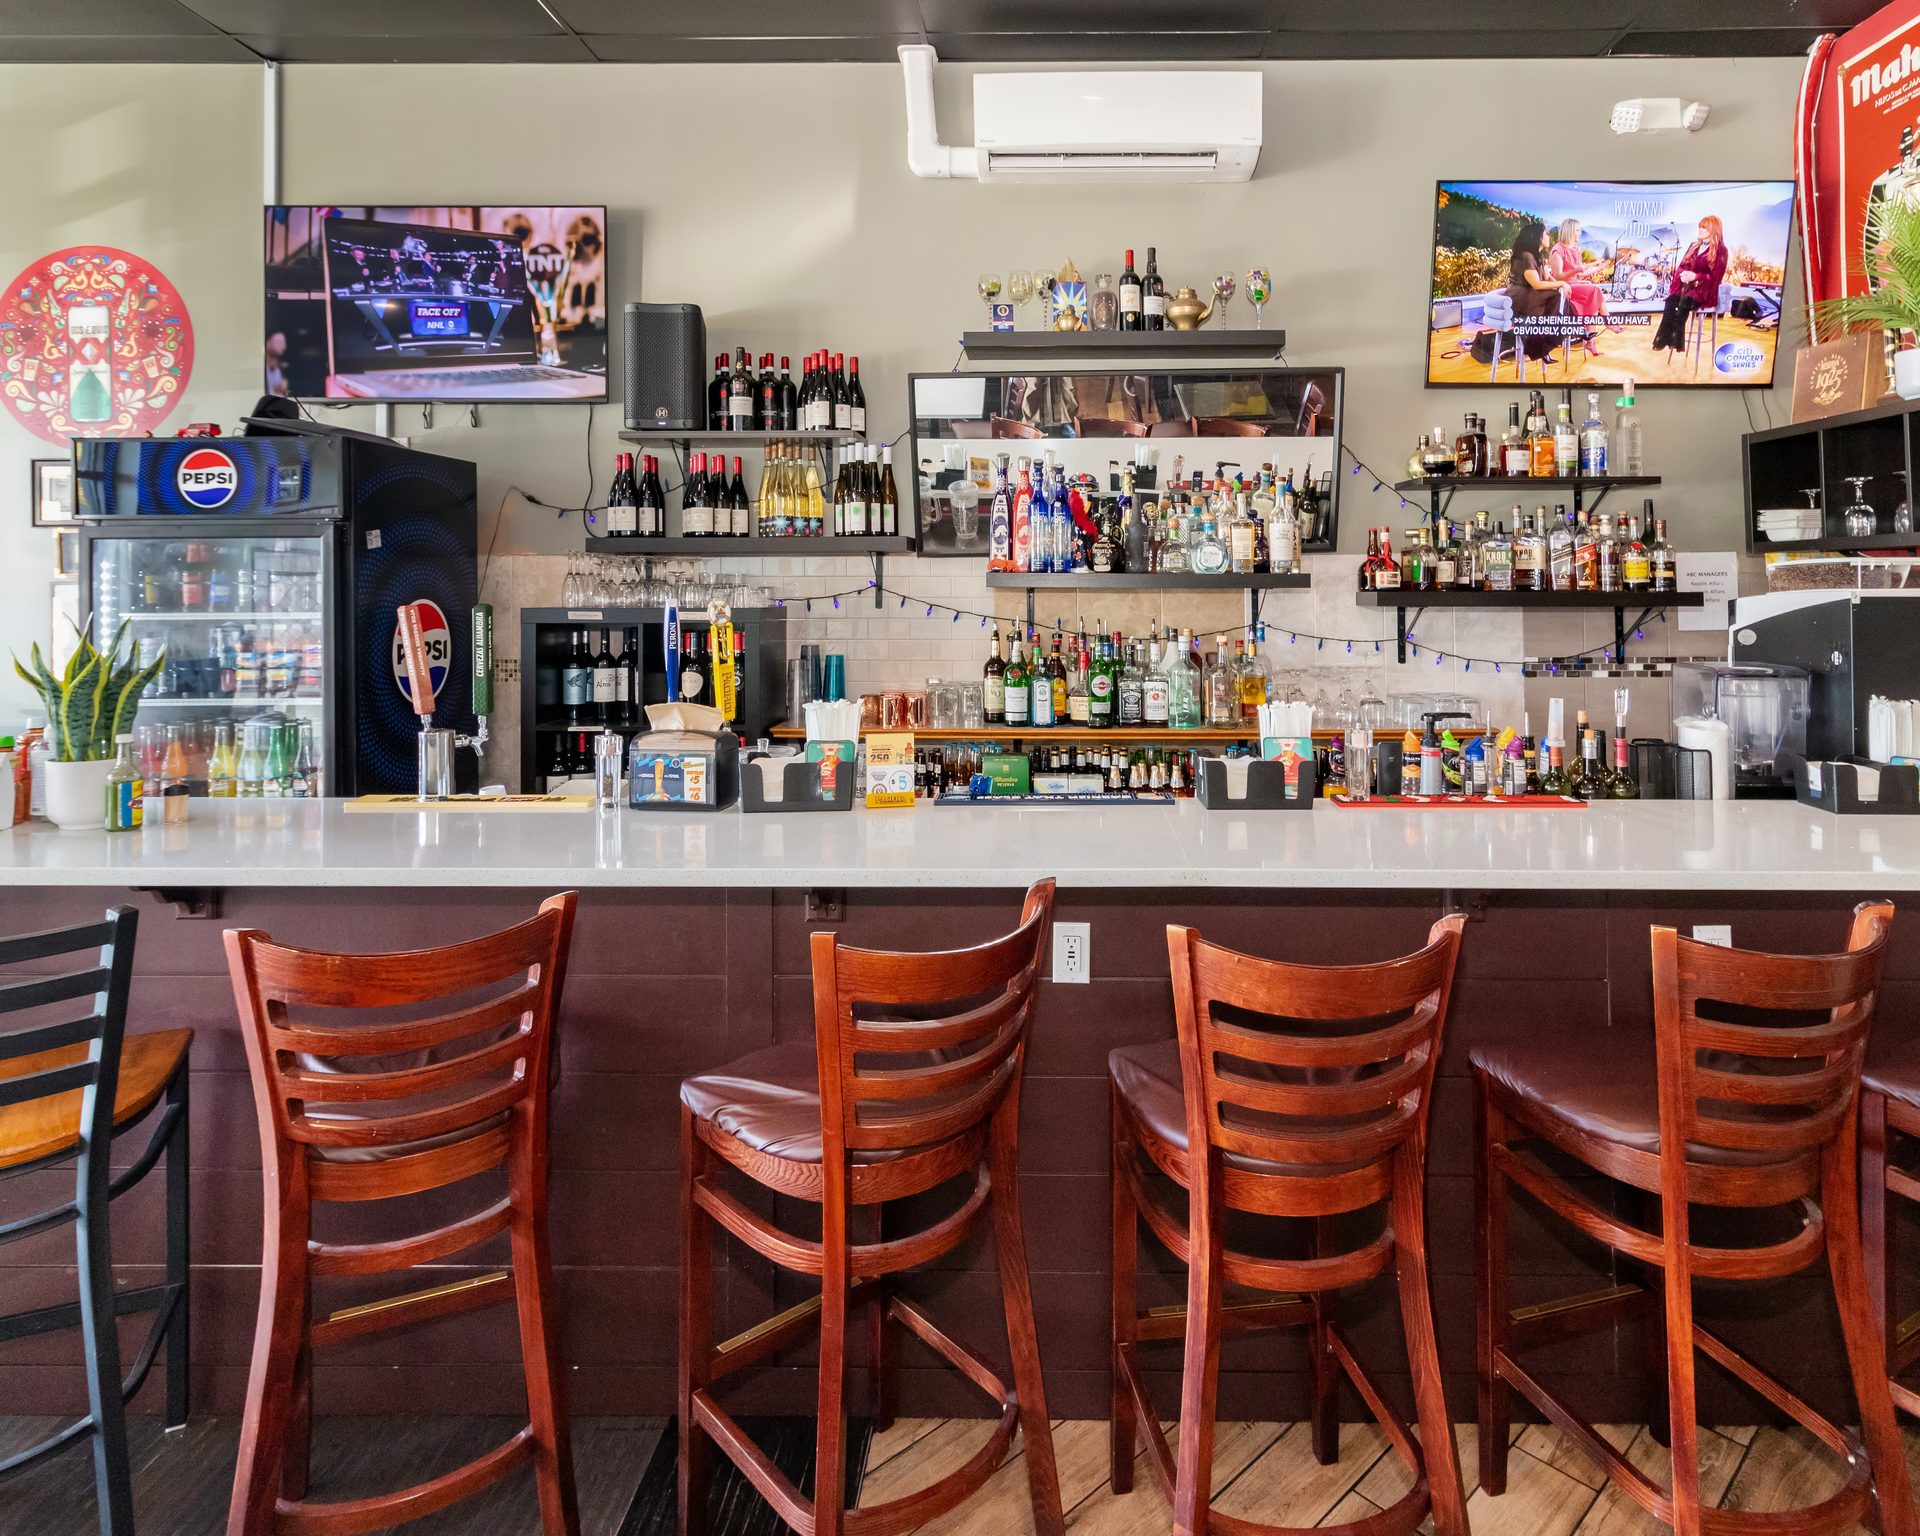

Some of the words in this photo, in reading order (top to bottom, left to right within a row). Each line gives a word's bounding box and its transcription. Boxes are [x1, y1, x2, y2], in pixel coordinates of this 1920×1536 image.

[1614, 200, 1663, 217] WYNONNA
[1623, 222, 1651, 238] JUDD
[527, 254, 563, 272] TNT
[417, 307, 441, 316] FACE
[442, 307, 461, 316] OFF
[427, 321, 445, 329] NHL
[1525, 316, 1537, 325] AS
[1538, 316, 1583, 325] SHEINELLE
[1584, 316, 1605, 326] SAID,
[1606, 316, 1624, 325] YOU
[1625, 316, 1650, 326] HAVE,
[1513, 326, 1559, 336] OBVIOUSLY,
[1560, 326, 1585, 335] GONE
[1815, 366, 1844, 395] 1925
[182, 472, 233, 484] PEPSI
[1486, 551, 1506, 560] KNOB
[409, 608, 417, 624] ROJA
[475, 612, 484, 646] ALHAMBRA
[669, 622, 677, 649] PERONI
[397, 640, 448, 665] PPSI
[475, 647, 484, 677] CERVEZAS
[870, 754, 890, 763] 250
[898, 775, 907, 790] 5
